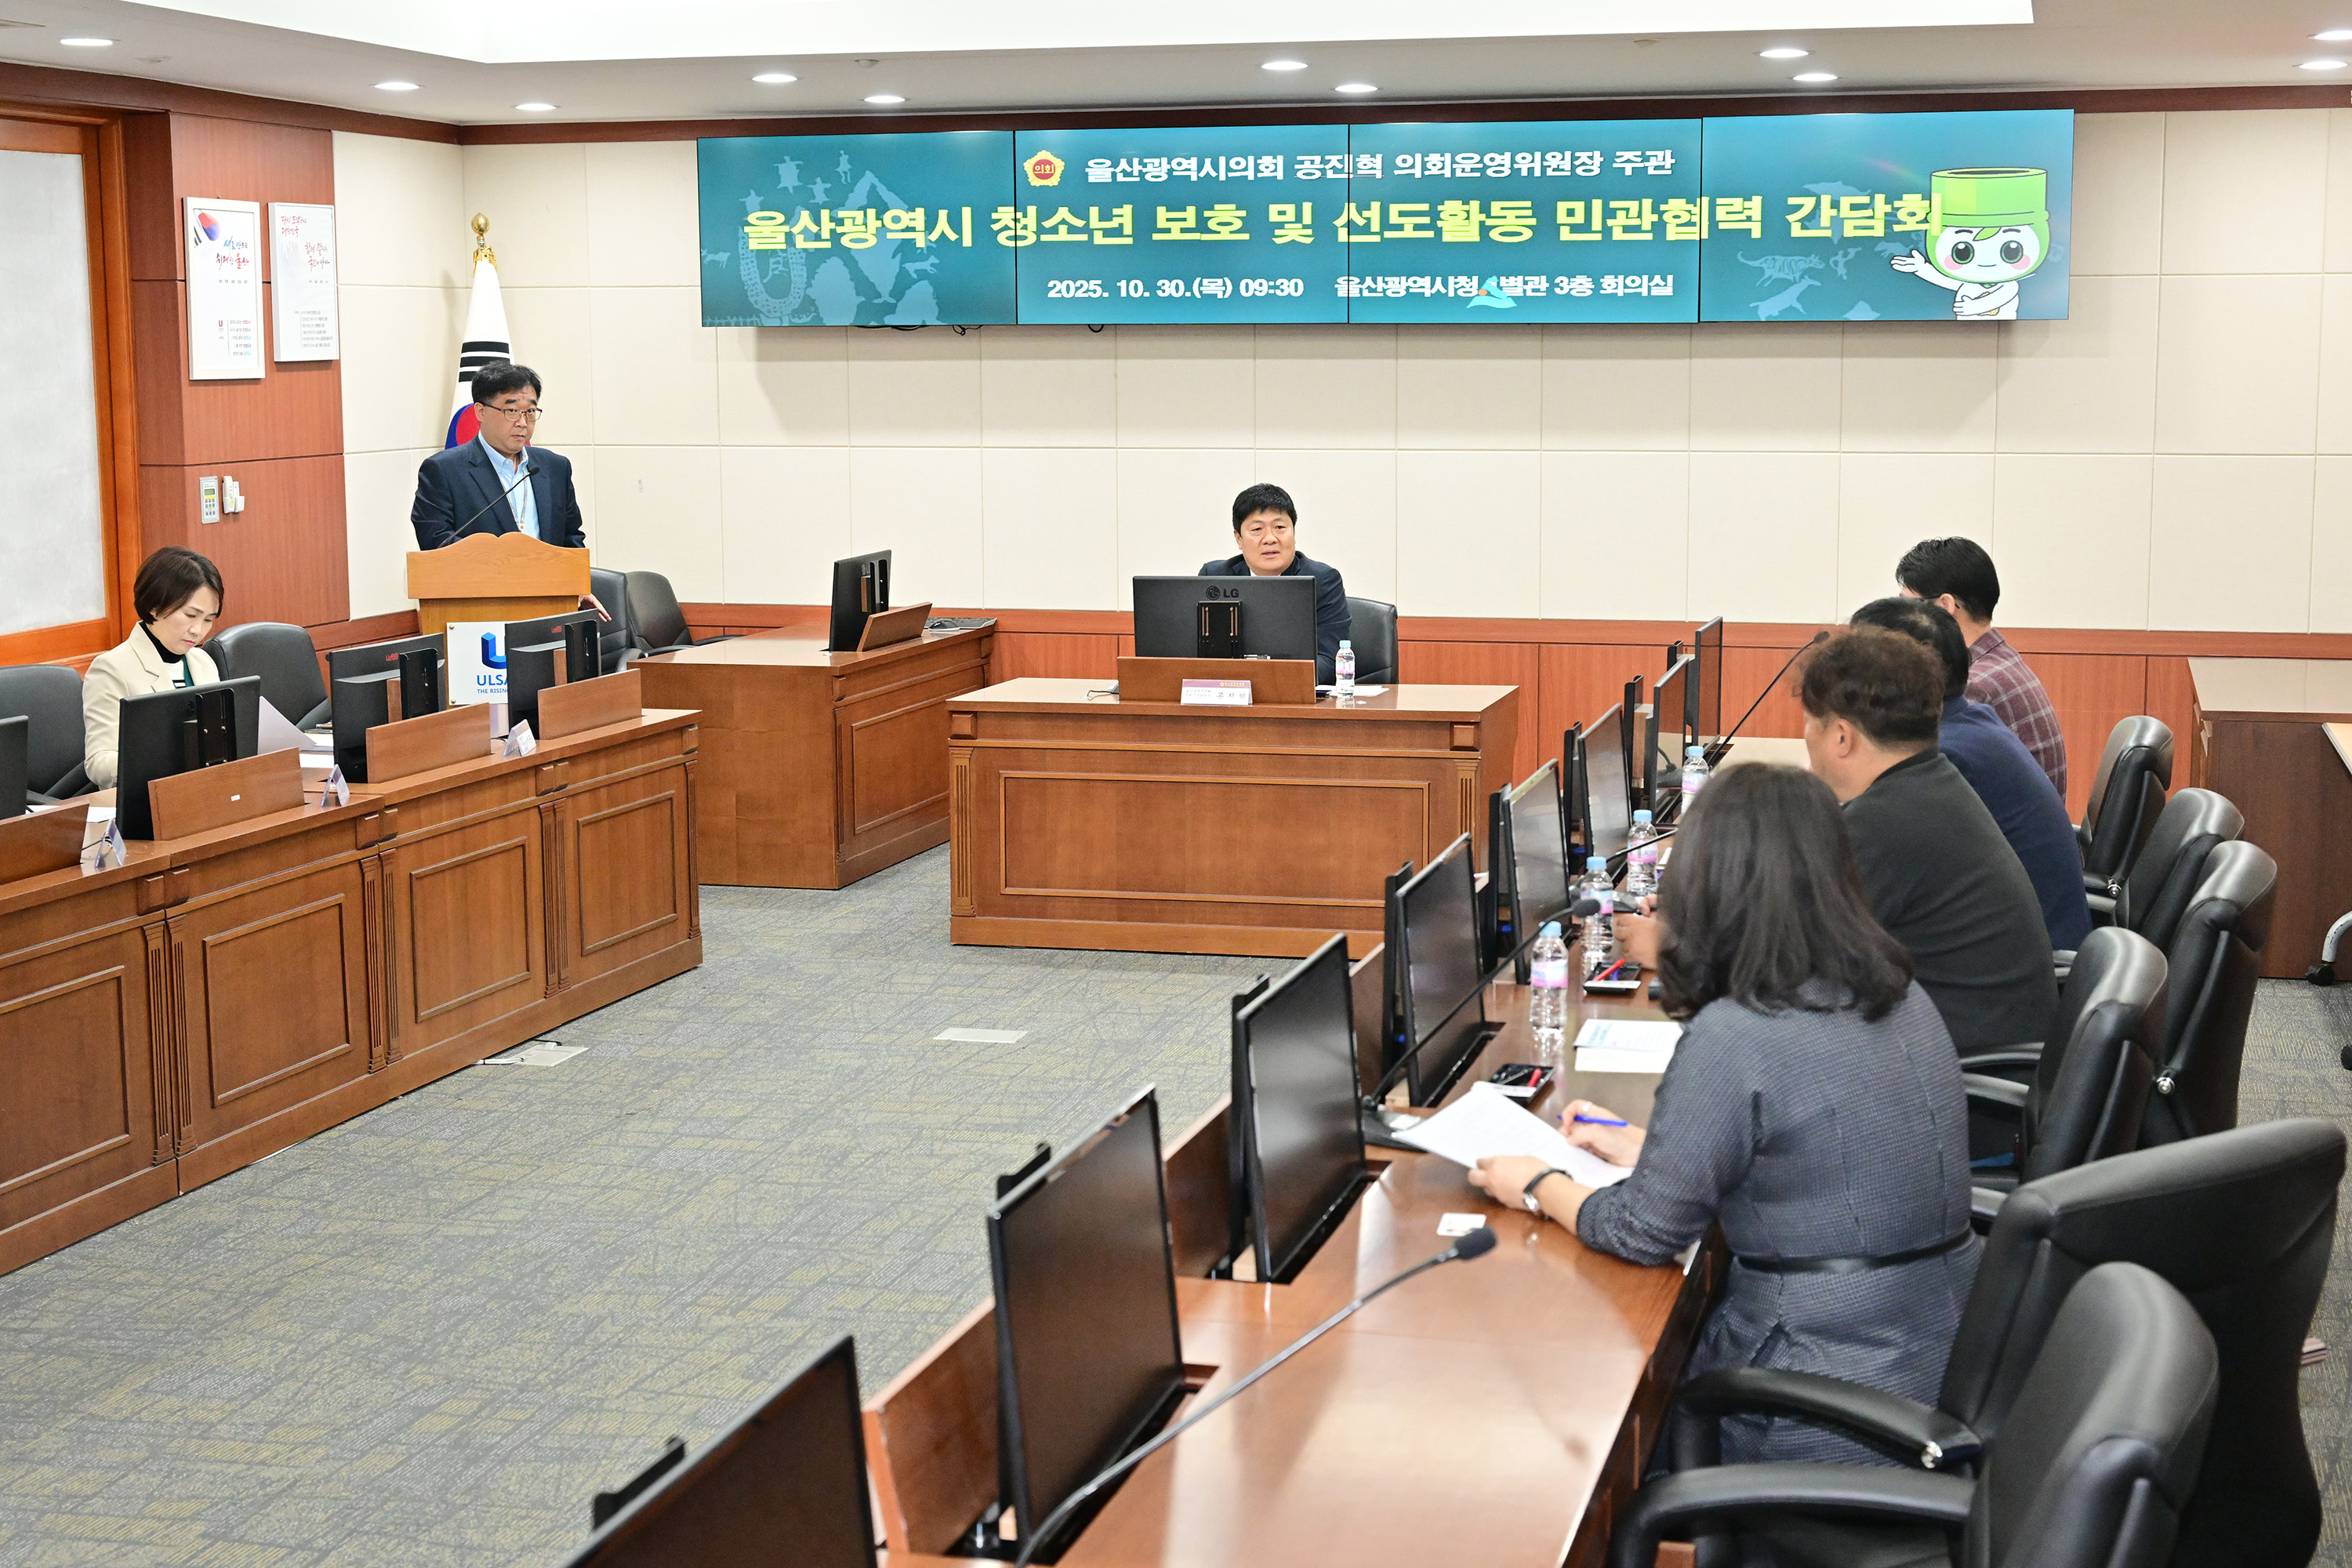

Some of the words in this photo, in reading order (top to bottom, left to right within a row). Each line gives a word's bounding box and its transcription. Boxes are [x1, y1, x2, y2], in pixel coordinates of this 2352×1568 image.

[1033, 164, 1054, 174] 의회
[1085, 155, 1283, 182] 울산광역시의회
[1294, 154, 1383, 180] 공진혁
[1394, 151, 1604, 178] 의회운영위원장
[1613, 150, 1676, 176] 주관
[744, 206, 972, 249] 울산광역시
[990, 205, 1134, 247] 청소년
[1152, 204, 1250, 241] 보호
[1269, 201, 1316, 245] 및
[1333, 200, 1537, 243] 선도활동
[1556, 196, 1763, 241] 민관협력
[1784, 193, 1942, 238] 간담회
[1047, 280, 1109, 298] 2025.
[1116, 280, 1150, 298] 10.
[1156, 278, 1232, 299] 30.(목)
[1240, 278, 1305, 298] 09:30
[1553, 275, 1595, 296] 3층
[1599, 274, 1674, 296] 회의실
[1223, 588, 1240, 598] LG
